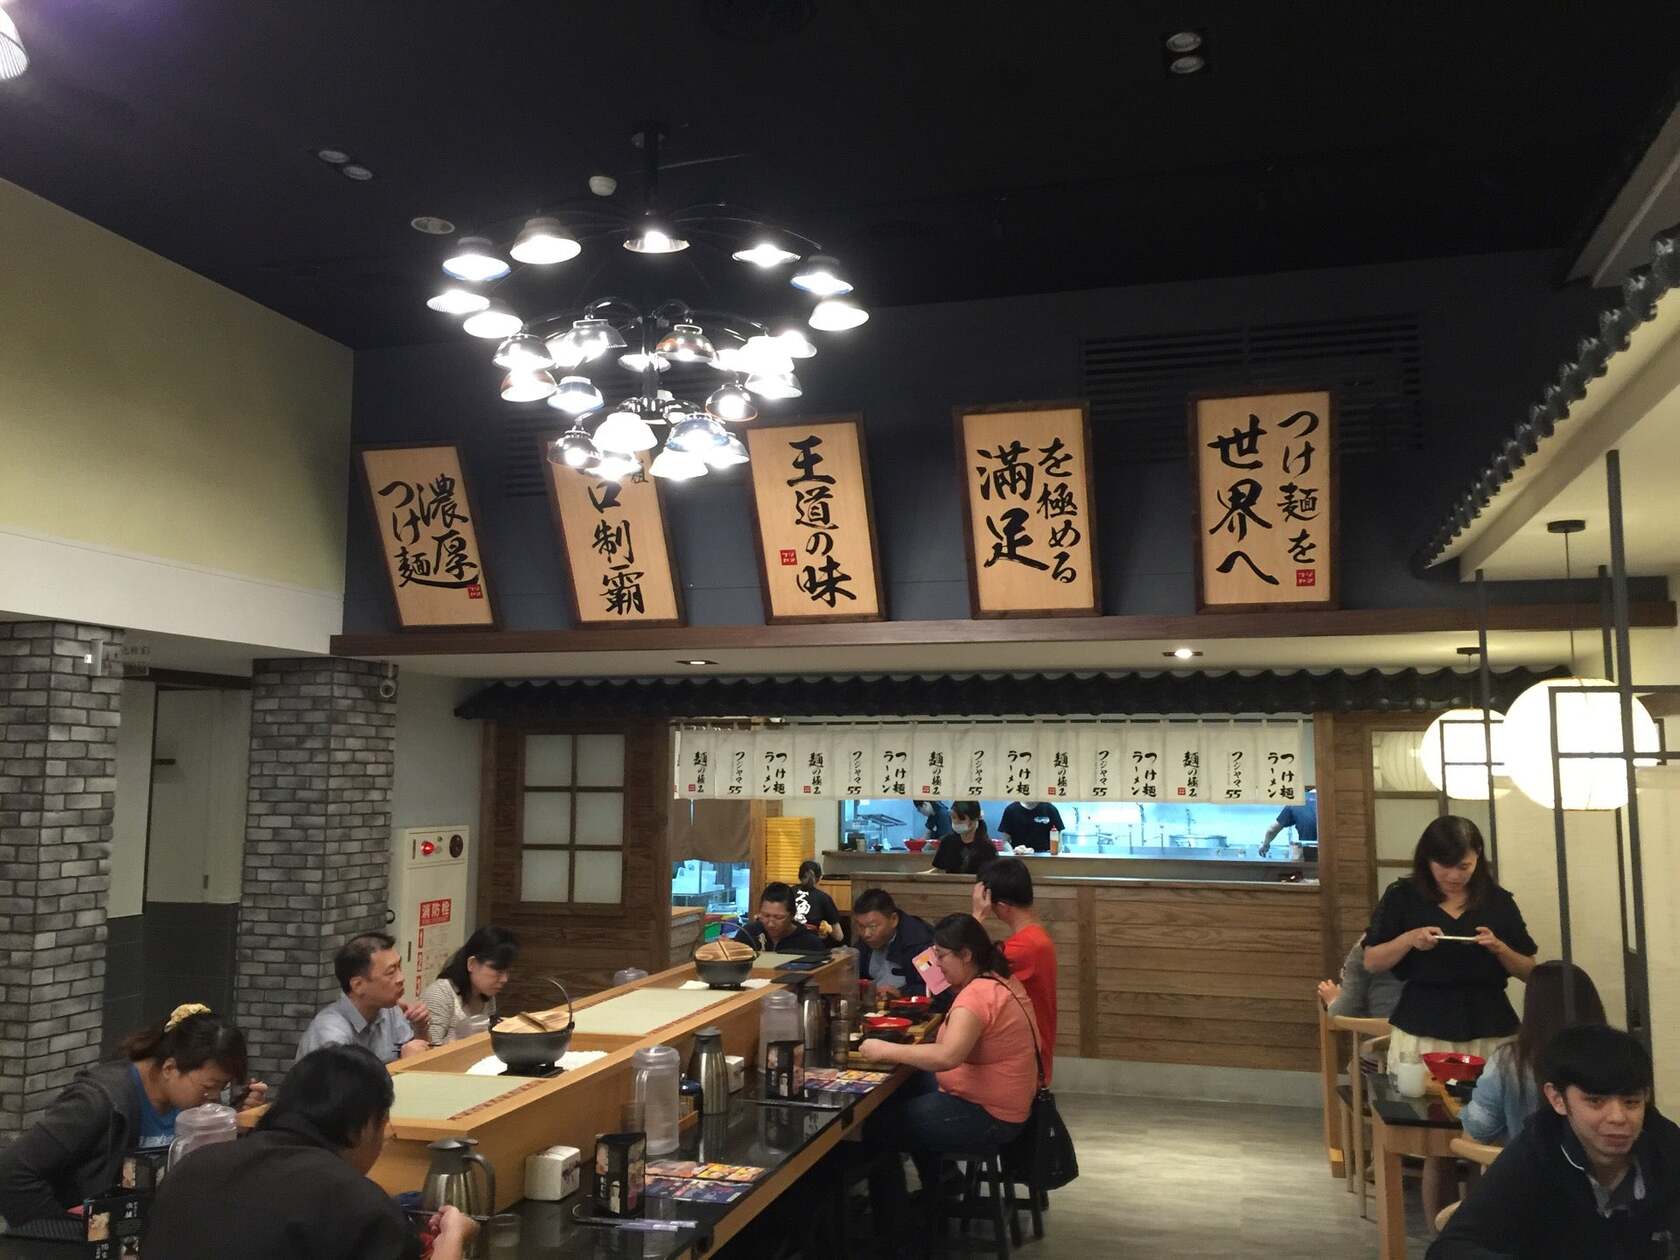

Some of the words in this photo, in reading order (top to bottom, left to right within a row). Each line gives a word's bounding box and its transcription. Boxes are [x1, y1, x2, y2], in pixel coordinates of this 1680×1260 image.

[787, 435, 857, 608] 王道の味
[1037, 437, 1081, 583] を極める
[1207, 414, 1280, 586] 世界へ
[416, 473, 478, 580] 濃厚
[763, 751, 774, 793] ラーメン
[882, 751, 893, 793] ラーメン
[1006, 751, 1018, 794] ラーメン
[1131, 751, 1144, 795] ラーメン
[1267, 753, 1279, 798] ラーメン
